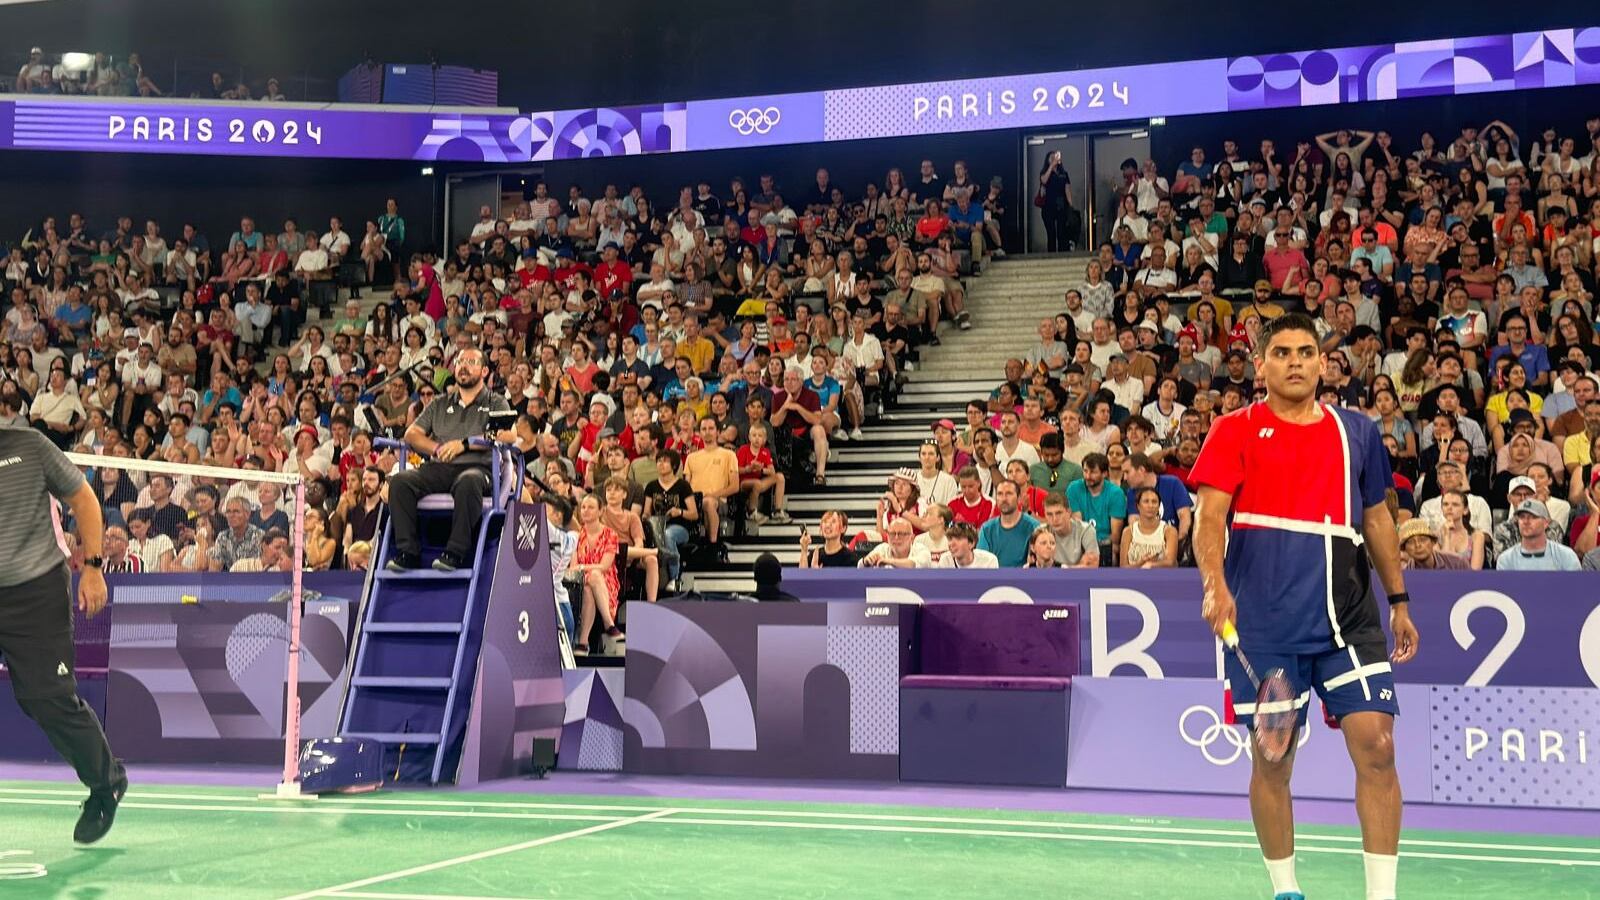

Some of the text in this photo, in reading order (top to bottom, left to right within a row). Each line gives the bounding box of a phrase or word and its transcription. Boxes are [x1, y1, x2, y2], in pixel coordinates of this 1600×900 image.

[913, 81, 1129, 121] PARIS 2024
[109, 115, 322, 145] PARIS 2024
[518, 611, 530, 643] 3
